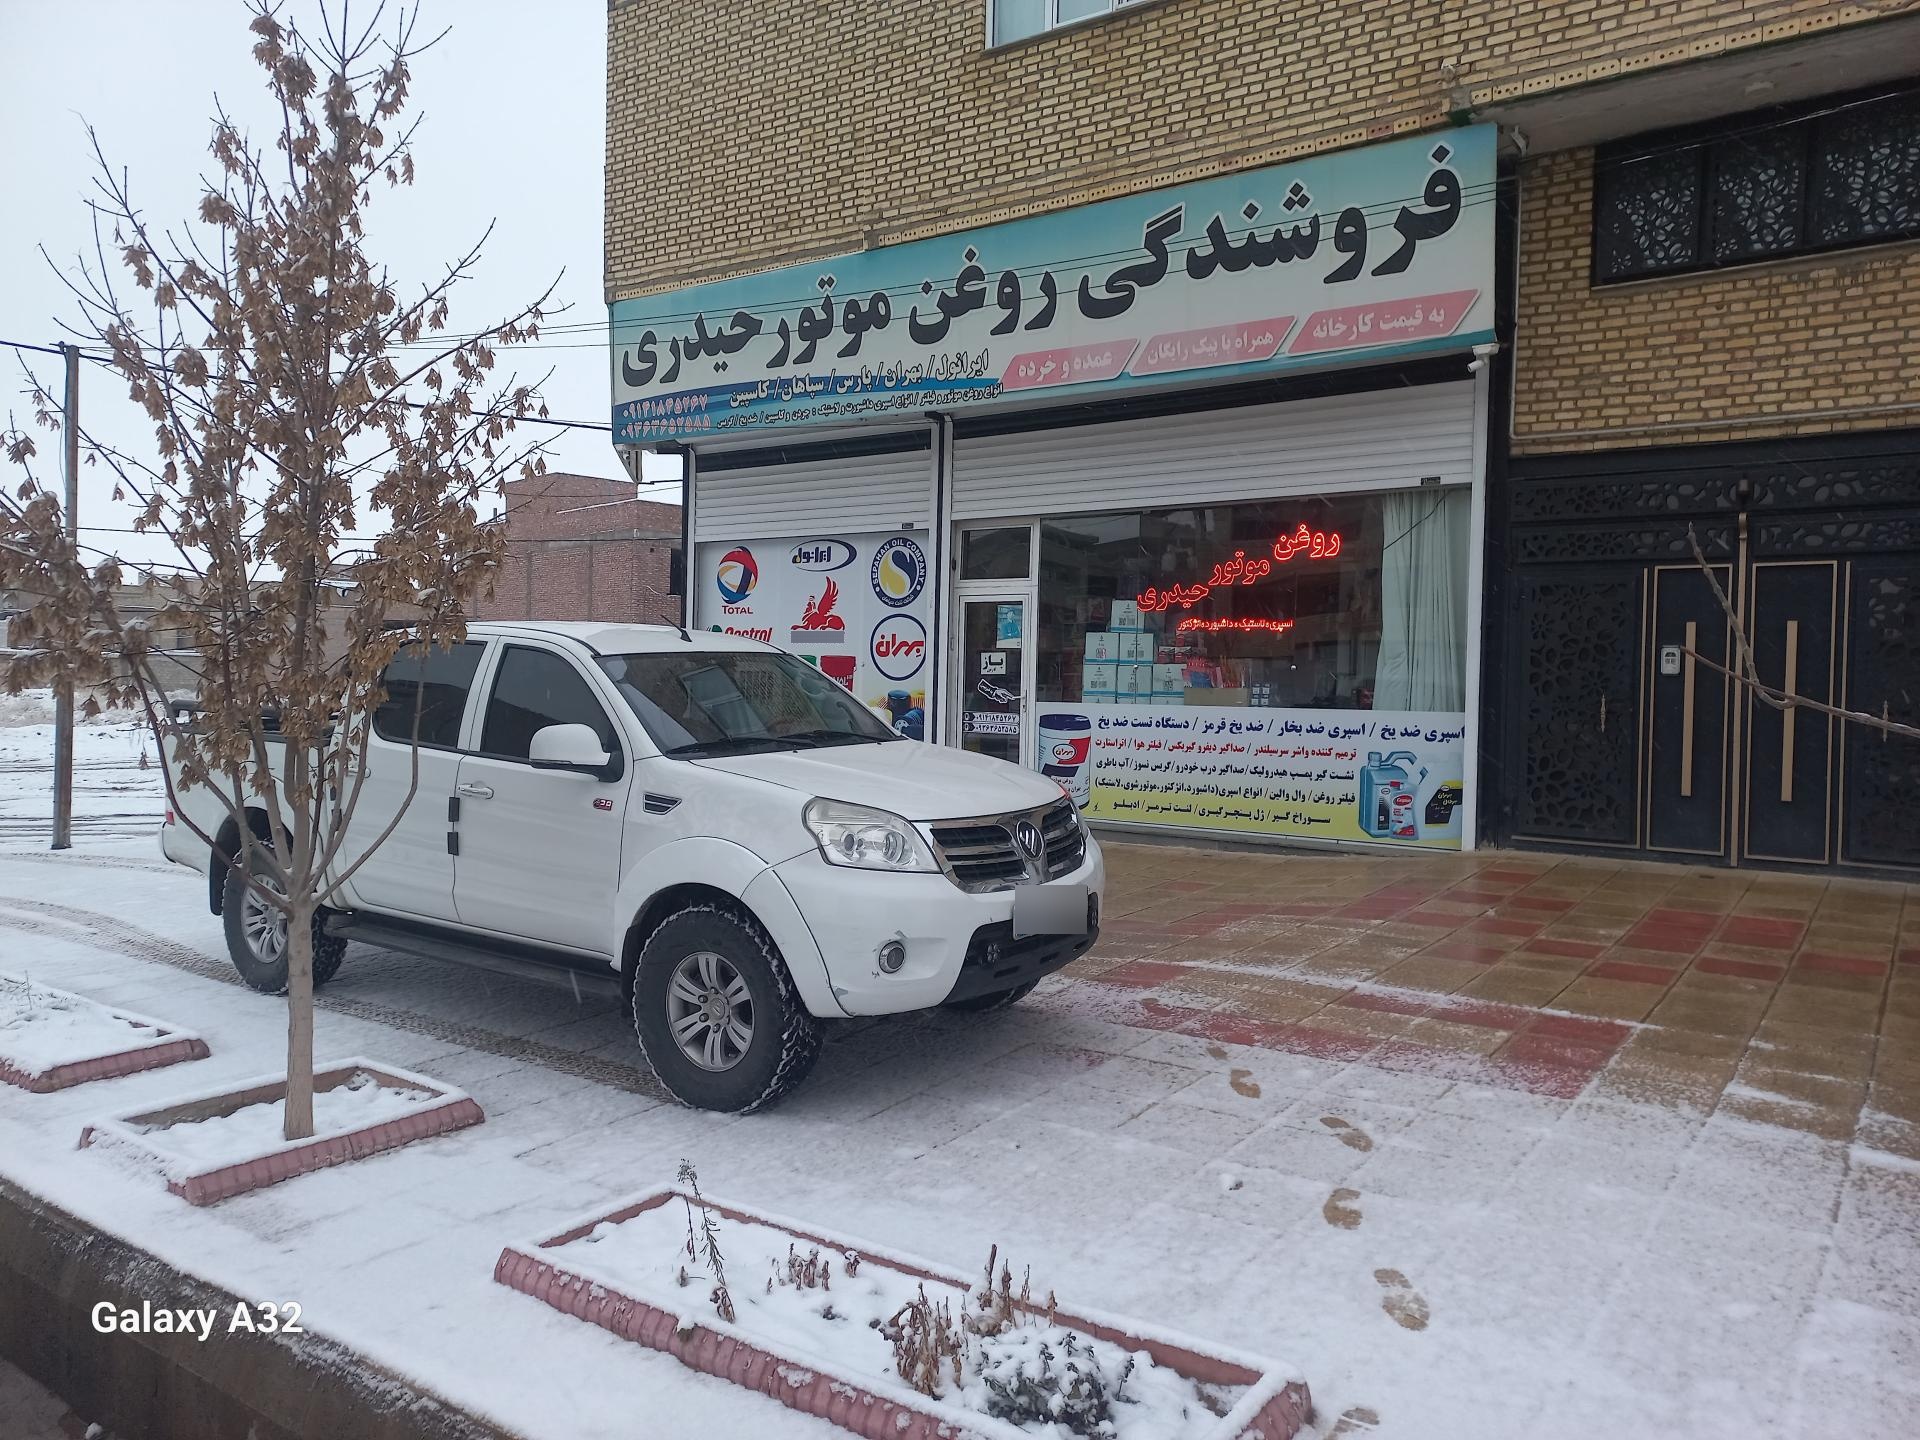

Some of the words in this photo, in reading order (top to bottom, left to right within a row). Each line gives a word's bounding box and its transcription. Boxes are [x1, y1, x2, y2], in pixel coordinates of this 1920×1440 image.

[1077, 144, 1463, 320] فروشندگی
[908, 247, 1057, 346] روغن
[766, 275, 892, 369] موتور
[1312, 312, 1375, 341] کارخانه
[1379, 304, 1423, 331] قیمت
[1428, 306, 1445, 328] به
[621, 309, 763, 387] حیدری
[1192, 337, 1218, 357] پیک
[1221, 334, 1231, 354] با
[1235, 332, 1274, 353] همراه
[1073, 351, 1113, 371] عمده
[1147, 341, 1189, 365] رایگان
[1018, 354, 1057, 382] خرده
[1060, 360, 1070, 379] و
[729, 380, 771, 408] کاسپین
[1274, 523, 1341, 561] روغن
[873, 543, 890, 584] SEPAHAN
[891, 539, 904, 547] OIL
[906, 541, 925, 584] COMPANY
[1208, 551, 1271, 585] موتور
[1137, 583, 1210, 612] حیدری
[982, 654, 1004, 670] باز
[1098, 715, 1110, 730] یخ
[1112, 715, 1128, 728] ضد
[1130, 716, 1153, 728] تست
[1155, 716, 1190, 730] دستگاه
[1202, 717, 1226, 734] قرمز
[1229, 719, 1242, 734] یخ
[1245, 719, 1264, 732] ضد
[1277, 719, 1302, 737] بخار
[1305, 721, 1325, 734] ضد
[1328, 723, 1365, 739] اسپری
[1380, 724, 1396, 740] یخ
[1400, 725, 1421, 738] ضد
[1424, 726, 1465, 743] اسپری
[1311, 747, 1333, 758] کننده
[1335, 748, 1357, 761] ترمیم
[1200, 764, 1217, 775] درب
